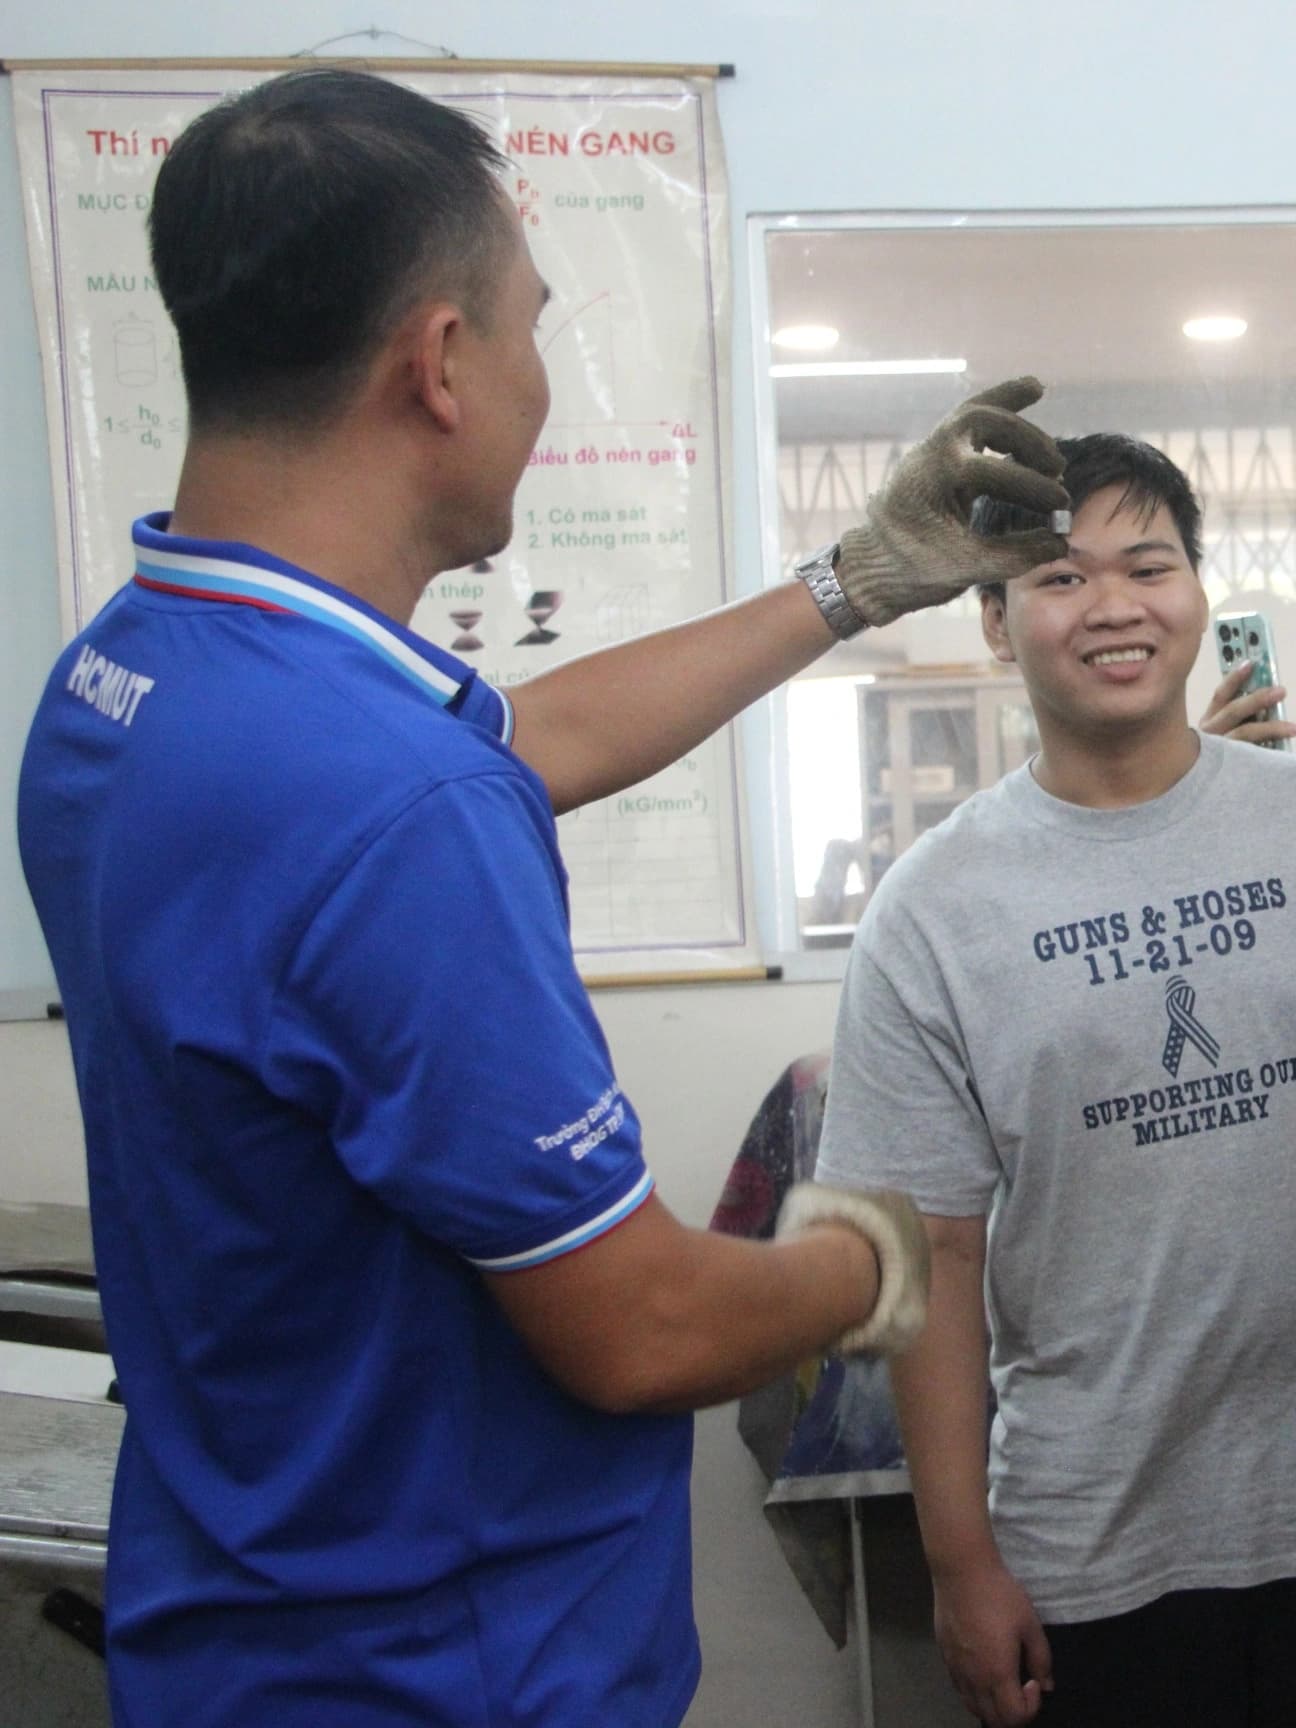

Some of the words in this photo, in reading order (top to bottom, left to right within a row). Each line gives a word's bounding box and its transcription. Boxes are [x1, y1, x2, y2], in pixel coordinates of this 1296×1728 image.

[86, 129, 139, 156] Thí
[505, 124, 570, 156] NÉN
[579, 131, 676, 156] GANG
[595, 193, 645, 213] gang
[647, 447, 697, 466] gag
[581, 511, 612, 523] ma
[66, 643, 155, 727] HCMUT
[1033, 912, 1130, 962] GUNS
[1141, 905, 1167, 936] &
[1173, 877, 1287, 929] HOSES
[1084, 919, 1256, 985] 11-21-09
[1082, 1068, 1254, 1129] SUPPORTING
[1132, 1094, 1270, 1146] MILITARY
